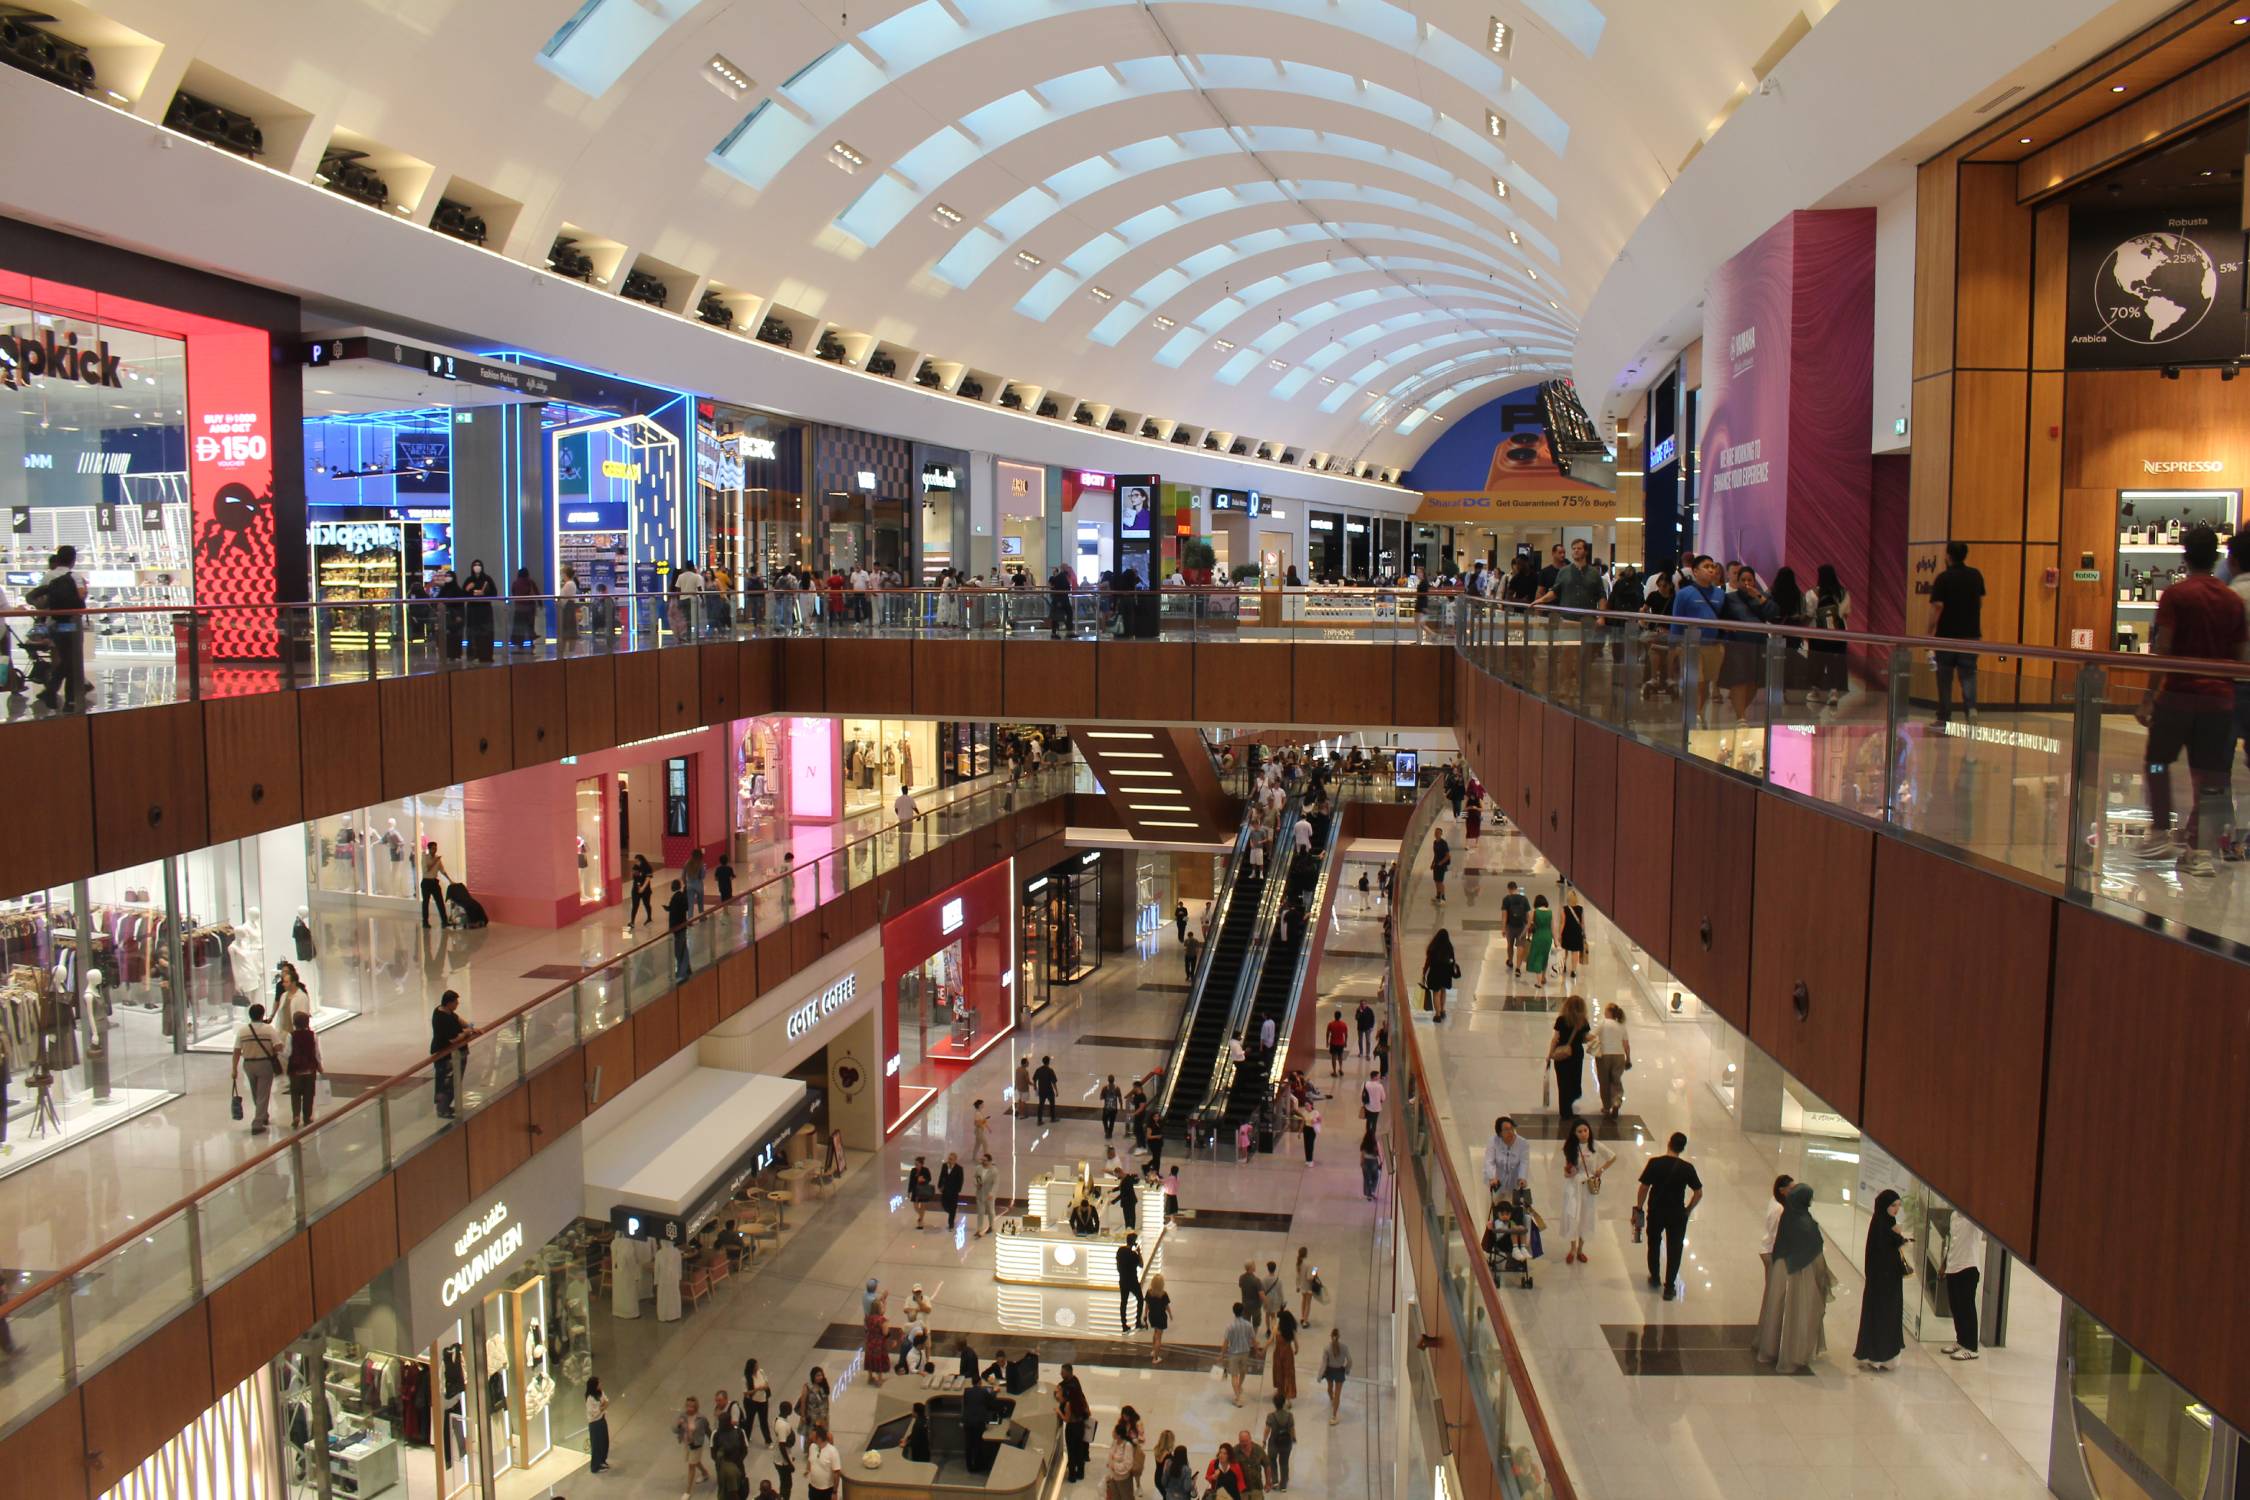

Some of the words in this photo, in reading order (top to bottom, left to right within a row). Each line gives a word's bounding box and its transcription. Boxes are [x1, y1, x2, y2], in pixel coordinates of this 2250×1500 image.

[2168, 218, 2209, 227] Robusta
[2173, 255, 2197, 264] 25%
[2219, 263, 2238, 273] 5%
[2110, 306, 2141, 319] 70%
[1736, 326, 1756, 357] YAMAHA
[2071, 335, 2107, 343] Arabica
[313, 345, 322, 362] P
[434, 356, 441, 372] P
[204, 414, 224, 424] BUY
[209, 424, 230, 433] AND
[231, 423, 252, 433] GET
[1743, 461, 1769, 487] EXPERIENCE
[2142, 459, 2224, 475] NESPRESSO
[1463, 497, 1491, 508] DG
[1496, 499, 1511, 508] Get
[1512, 499, 1560, 508] Guaranteed
[1561, 495, 1591, 508] 75%
[2075, 571, 2098, 580] tabby
[786, 998, 820, 1040] COSTA
[821, 973, 856, 1015] COFFEE
[758, 1154, 764, 1171] P
[628, 1217, 640, 1236] P
[442, 1249, 490, 1307] CALVIN
[489, 1222, 523, 1271] KLEIN
